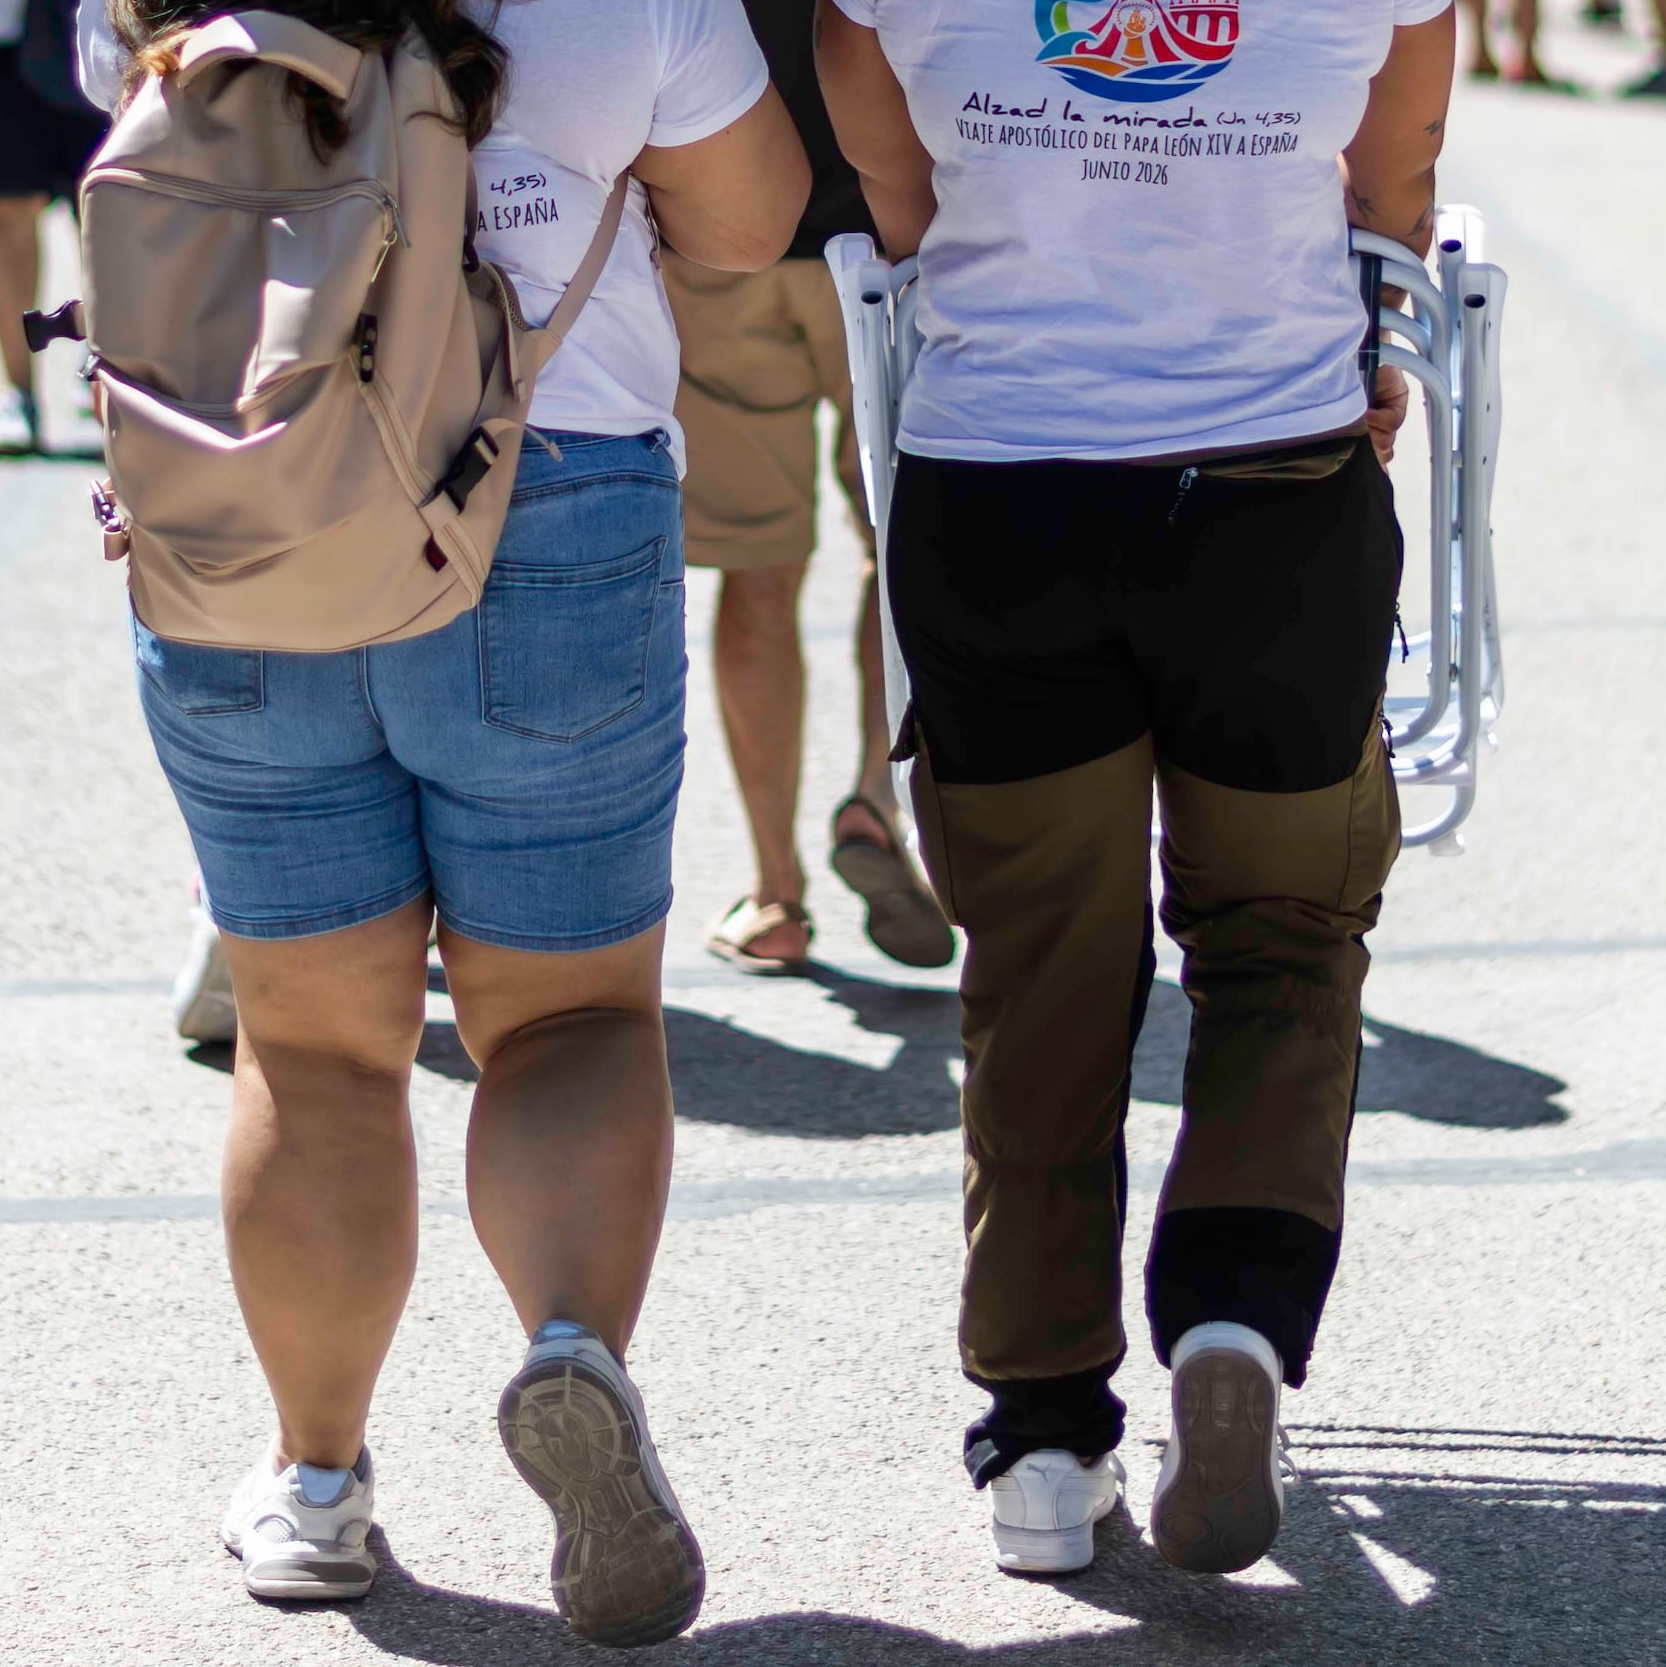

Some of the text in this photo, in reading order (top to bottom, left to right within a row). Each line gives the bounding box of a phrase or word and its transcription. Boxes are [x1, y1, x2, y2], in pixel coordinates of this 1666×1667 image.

[962, 91, 1302, 129] Alzad la mirada (Jn 4,35)
[955, 117, 1299, 157] VIAJE APOSTÓLICO DEL PAPA LEÓN XIV A ESPAÑA
[490, 172, 547, 197] 4,35)
[1081, 158, 1169, 186] JUNIO 2026
[494, 196, 560, 231] ESPAÑA
